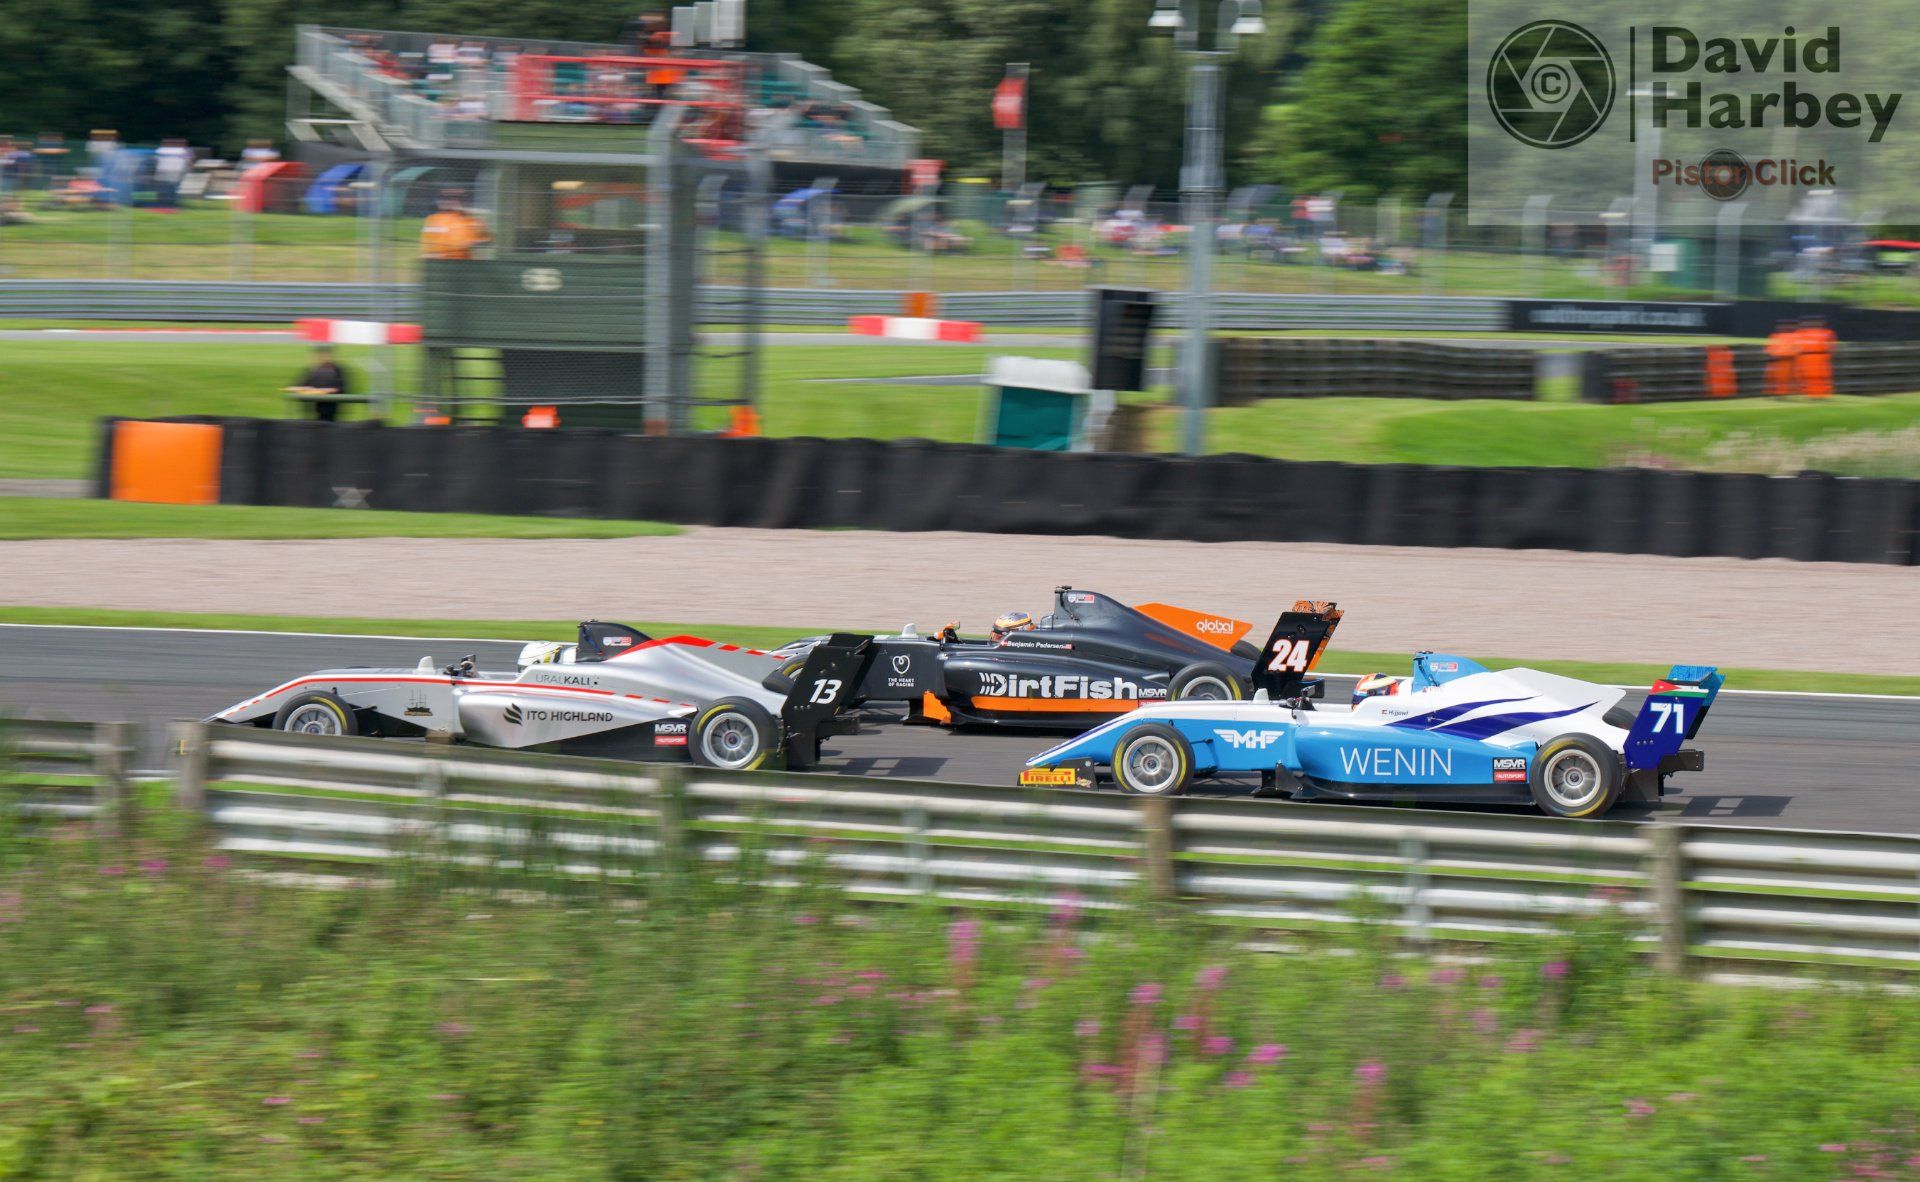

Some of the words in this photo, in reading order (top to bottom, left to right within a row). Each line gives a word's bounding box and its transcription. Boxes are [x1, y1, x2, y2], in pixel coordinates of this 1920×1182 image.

[1007, 640, 1035, 648] Benjamin
[1268, 639, 1310, 673] 24
[535, 674, 590, 686] URALKALI
[979, 672, 1138, 699] DirtFish
[809, 678, 842, 705] 13
[1138, 688, 1167, 698] MSVR
[526, 710, 548, 721] ITO
[550, 711, 614, 722] HIGHLAND
[1650, 702, 1684, 734] 71
[654, 723, 687, 732] MSVR
[1340, 746, 1452, 776] WENIN
[1493, 759, 1526, 768] MSVR
[1023, 770, 1072, 782] PIRELLI
